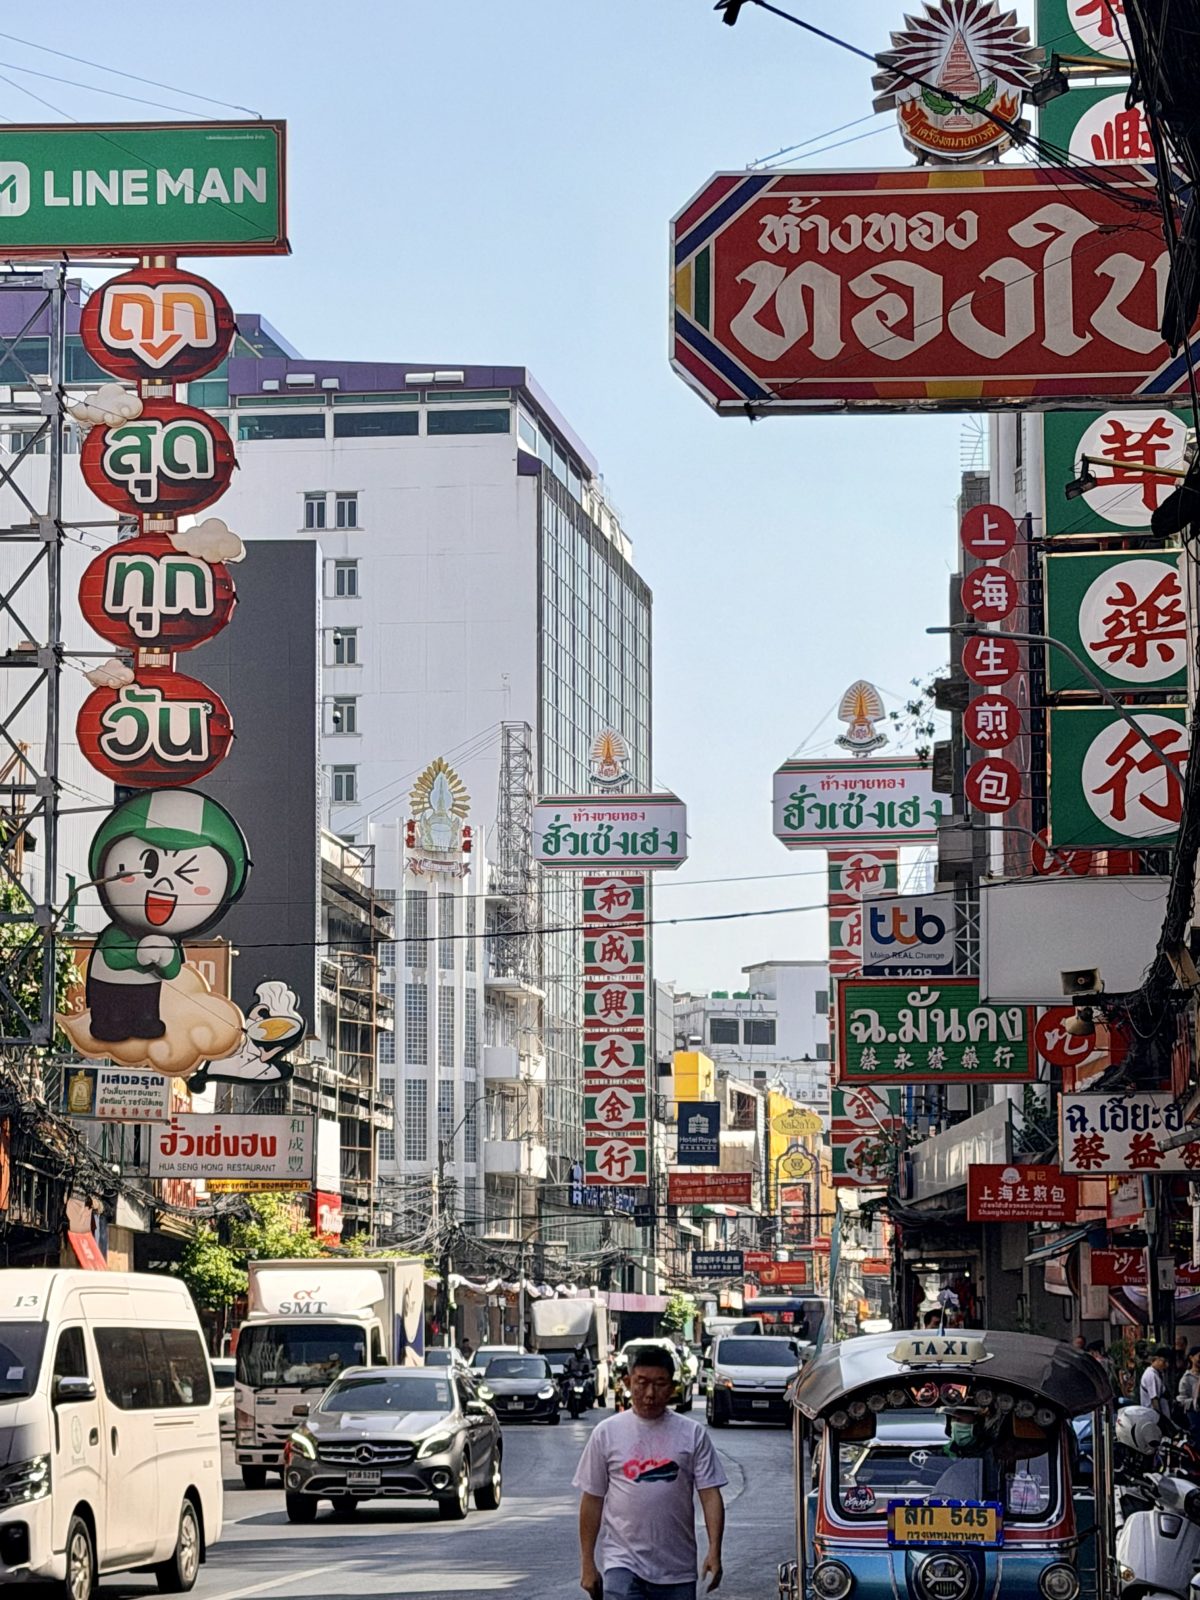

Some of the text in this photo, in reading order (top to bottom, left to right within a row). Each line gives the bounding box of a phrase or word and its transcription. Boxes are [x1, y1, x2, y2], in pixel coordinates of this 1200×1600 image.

[44, 169, 148, 207] LINE
[156, 167, 267, 205] MAN
[756, 197, 979, 254] ห้างทอง
[107, 424, 210, 500] สุด
[109, 559, 210, 633] ทุก
[820, 774, 906, 792] ห้างขายทอง
[572, 808, 646, 822] ห้างขายทอง
[869, 906, 946, 945] ttb
[915, 951, 945, 961] Change
[849, 985, 1023, 1044] ฉ.มั่นคง
[100, 1073, 165, 1090] แสงอรุณ
[158, 1162, 276, 1173] HUA SENG HONG RESTAURANT
[13, 1295, 39, 1308] 13
[278, 1301, 328, 1315] SMT
[911, 1341, 969, 1356] TAXI
[950, 1508, 989, 1527] 545
[906, 1530, 985, 1541] กรงเทพมหานคร
